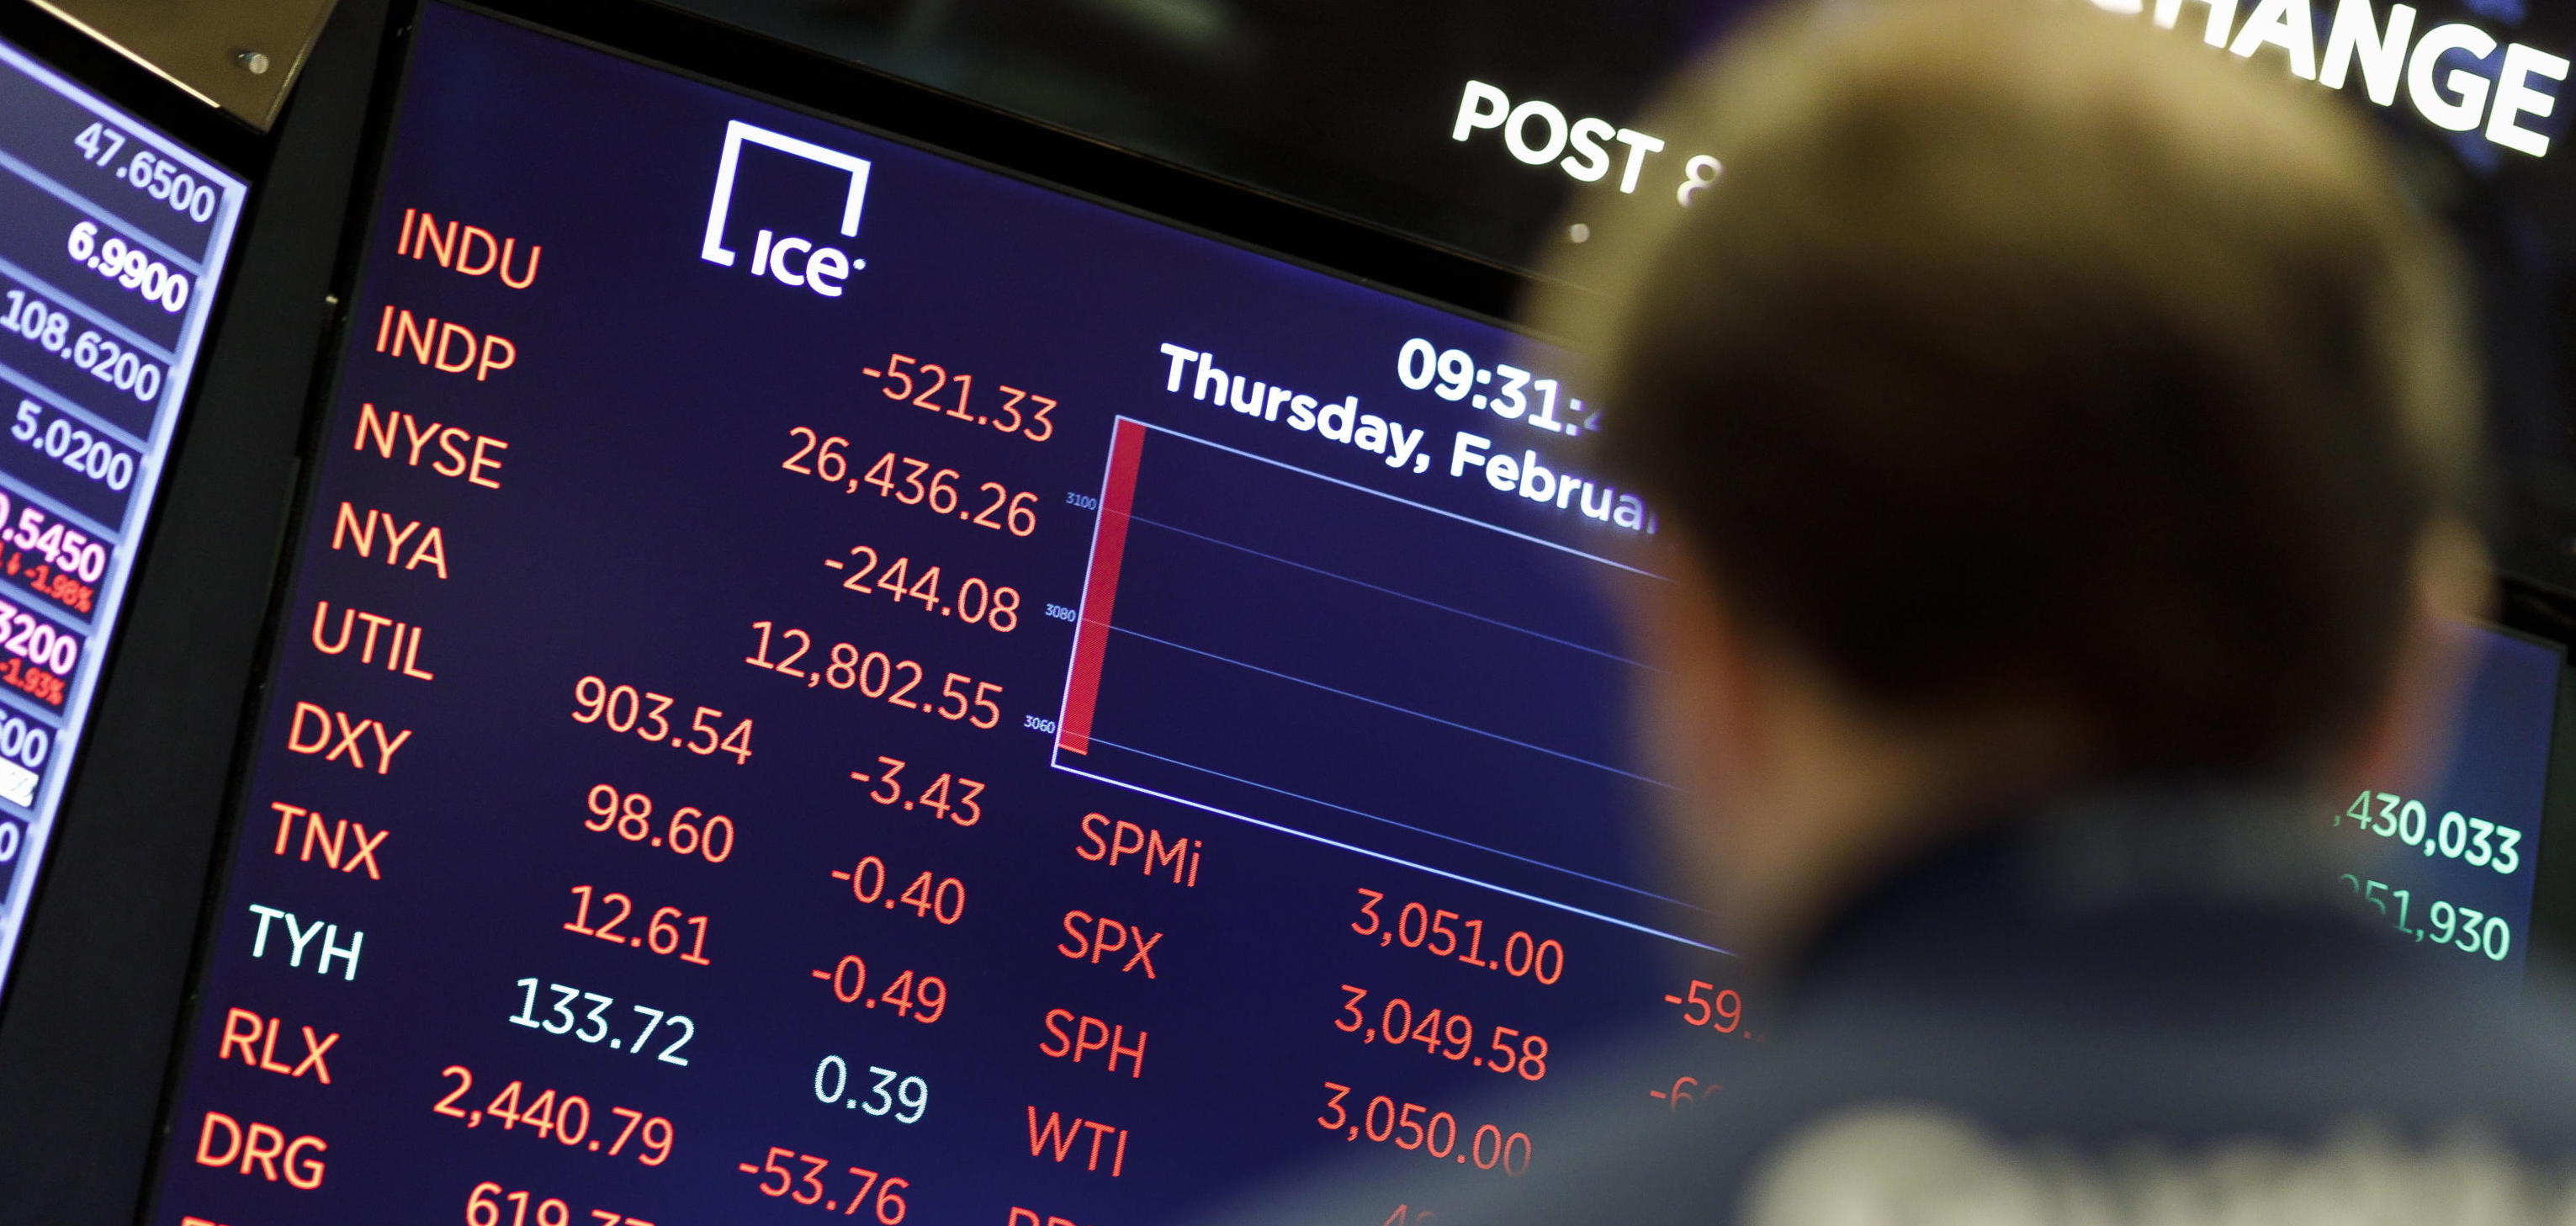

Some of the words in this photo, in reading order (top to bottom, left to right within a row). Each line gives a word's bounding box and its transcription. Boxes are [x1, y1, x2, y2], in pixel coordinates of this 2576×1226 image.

[74, 122, 215, 223] 47.6500
[1452, 79, 1664, 194] POST
[67, 220, 189, 312] 6.9900
[397, 208, 541, 289] INDU
[0, 289, 161, 401] 108.6200
[375, 305, 517, 382] INDP
[11, 399, 134, 491] 5.0200
[353, 402, 509, 490] NYSE
[862, 353, 1057, 442] -521.33
[1159, 342, 1430, 475] Thursday,
[782, 426, 1039, 537] 26,436.26
[1066, 491, 1097, 511] 3100
[331, 501, 448, 580] NYA
[824, 545, 1020, 633] -244.08
[1045, 602, 1077, 623] 3080
[311, 600, 434, 681] UTIL
[571, 675, 754, 766] 903.54
[745, 620, 1004, 730] 12,802.55
[1023, 714, 1056, 735] 3060
[0, 709, 48, 767] 00
[287, 701, 412, 775] DXY
[584, 783, 735, 863] 98.60
[851, 756, 986, 827] -3.43
[271, 801, 390, 881] TNX
[563, 884, 711, 966] 12.61
[831, 855, 966, 926] -0.40
[1075, 812, 1202, 888] SPMi
[1350, 887, 1565, 985] 3,051.00
[249, 904, 364, 981] TYH
[508, 977, 695, 1067] 133.72
[812, 954, 947, 1024] -0.49
[1057, 910, 1163, 979] SPX
[1333, 984, 1550, 1082] 3,049.58
[219, 1006, 340, 1085] RLX
[432, 1064, 674, 1167] 2,440.79
[814, 1054, 929, 1124] 0.39
[1039, 1008, 1148, 1079] SPH
[1317, 1081, 1533, 1177] 3,050.00
[195, 1111, 328, 1190] DRG
[739, 1146, 910, 1226] -53.76
[1027, 1105, 1128, 1178] WTI
